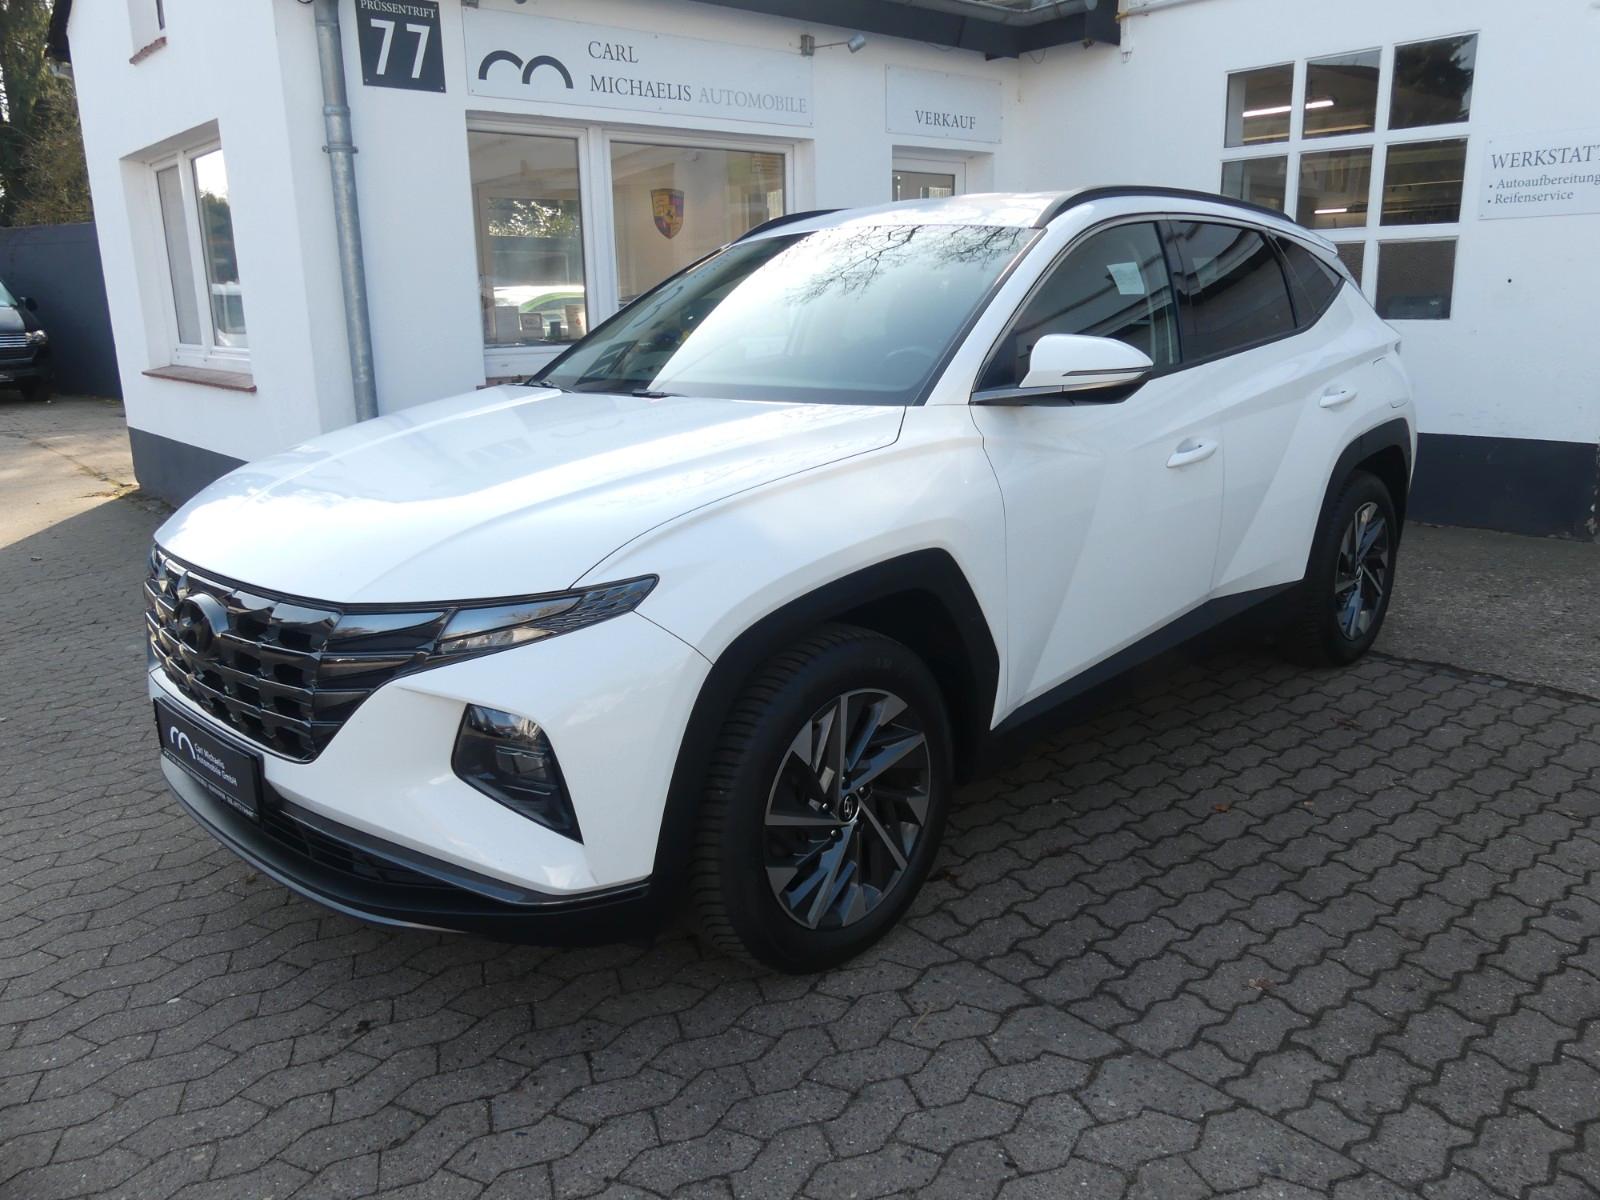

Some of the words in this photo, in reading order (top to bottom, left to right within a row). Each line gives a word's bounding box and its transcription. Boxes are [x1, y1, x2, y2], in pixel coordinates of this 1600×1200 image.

[360, 0, 436, 19] PRÜSSENTRIFT
[370, 18, 431, 79] 77
[587, 40, 640, 64] CARL
[590, 74, 692, 102] MICHAELIS
[699, 87, 808, 114] AUTOMOBILE
[914, 109, 977, 130] VERKAUF
[1494, 190, 1575, 204] Reifenservice
